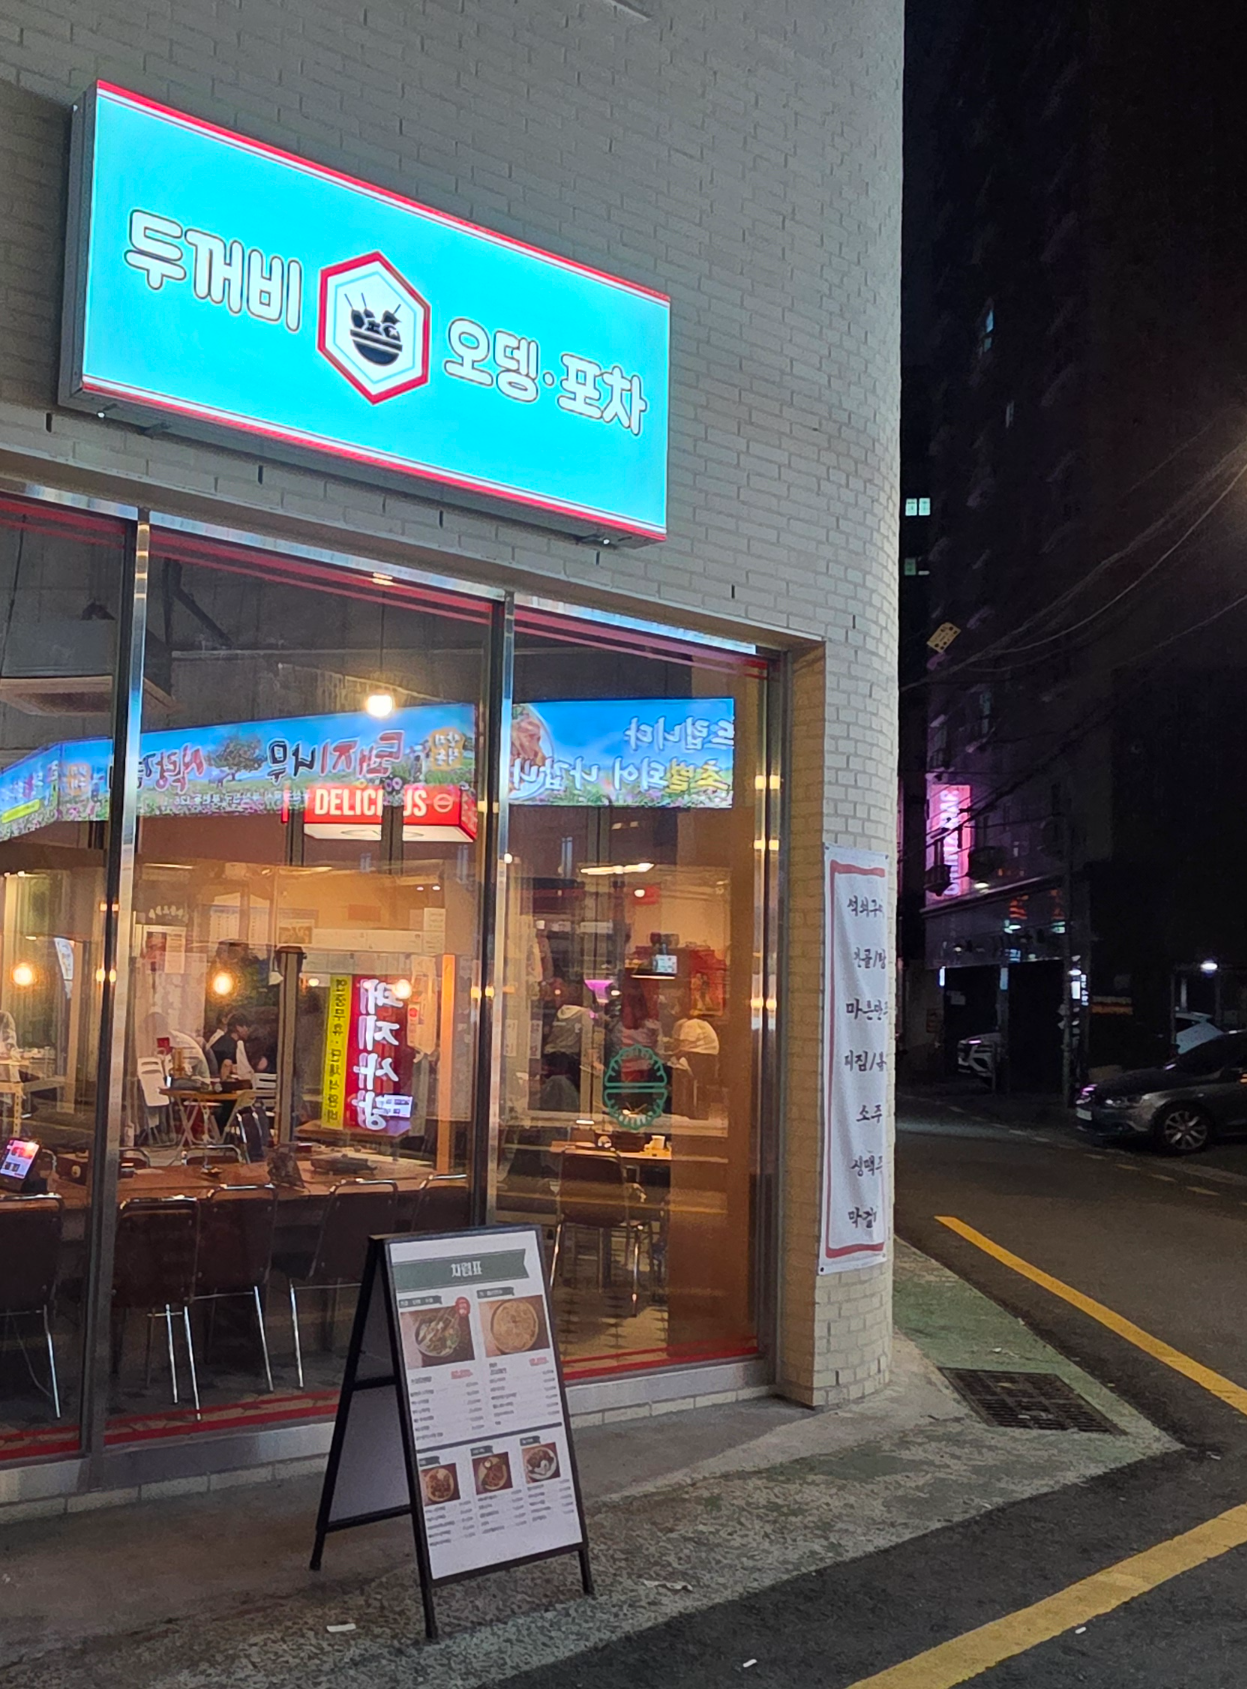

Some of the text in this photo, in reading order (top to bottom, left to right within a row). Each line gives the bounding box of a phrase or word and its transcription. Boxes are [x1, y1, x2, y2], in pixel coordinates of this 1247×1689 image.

[123, 209, 302, 333] 두꺼비
[314, 788, 428, 817] DELICIUS
[856, 1104, 883, 1124] 소주
